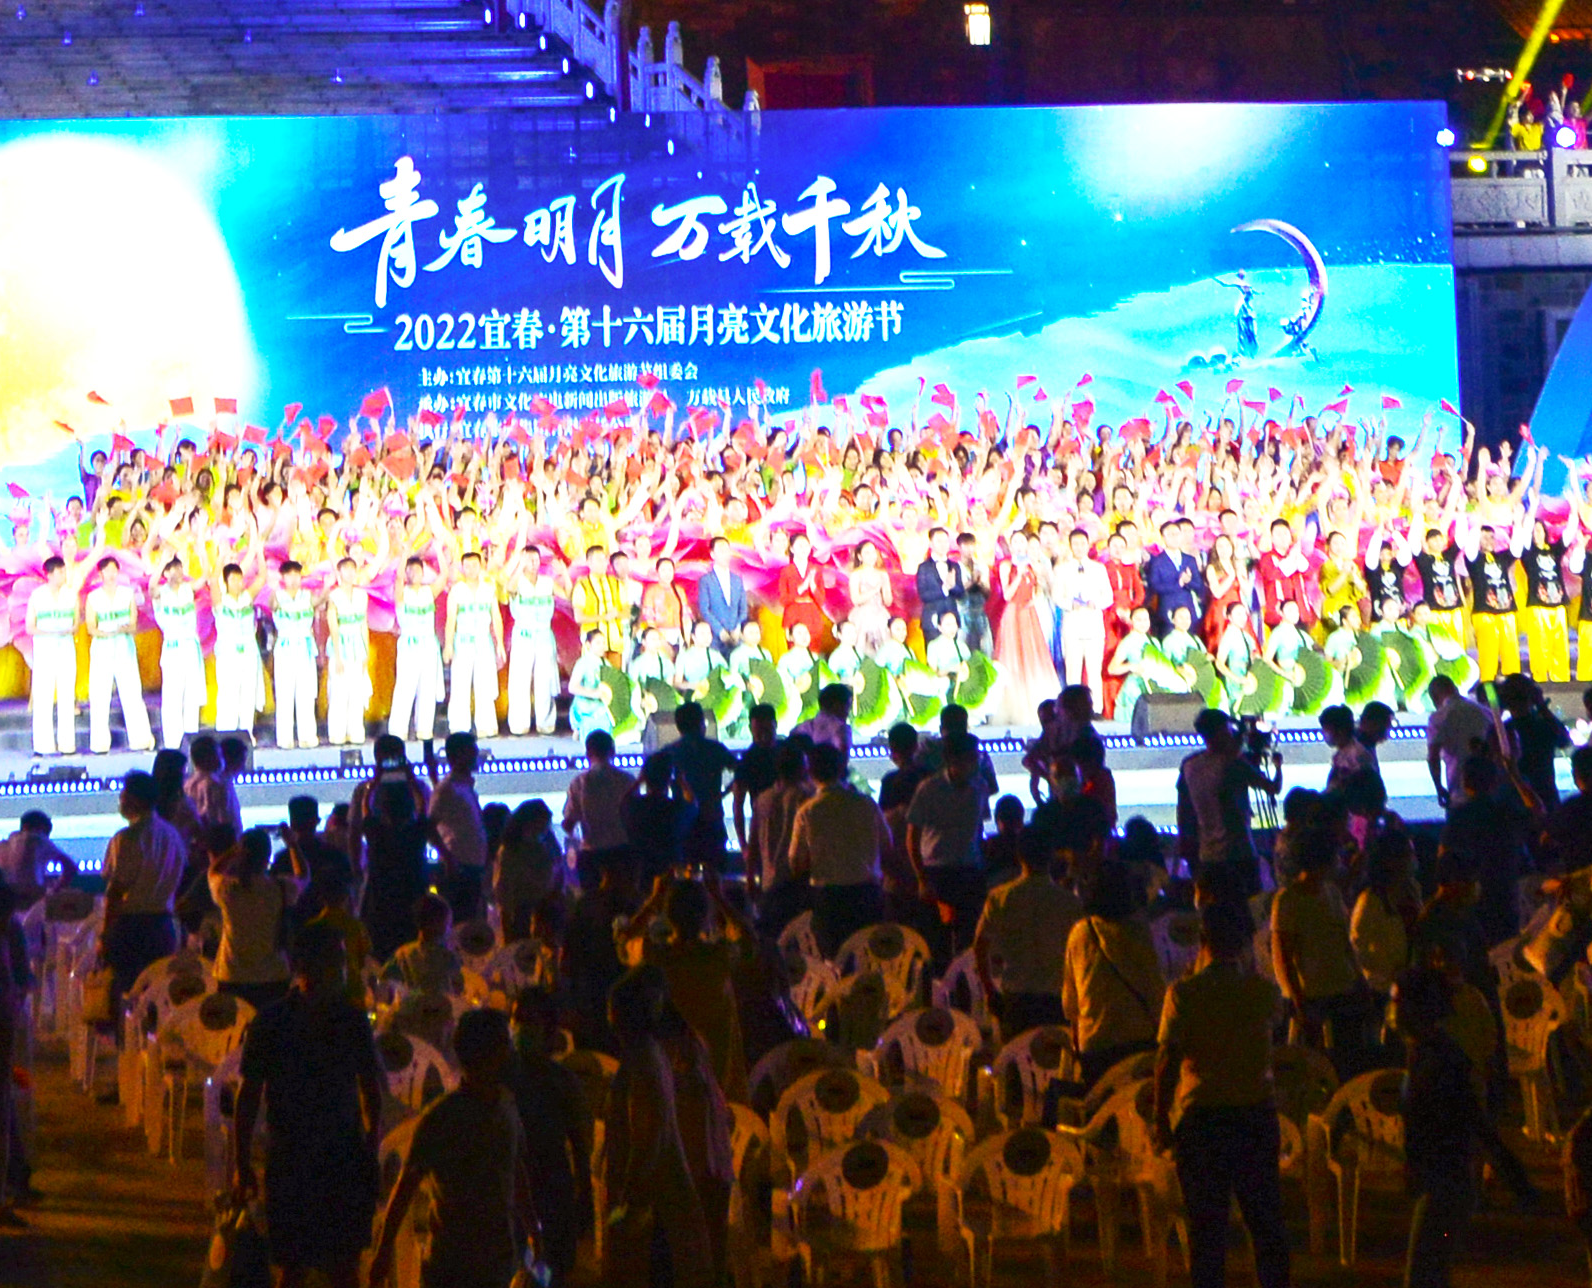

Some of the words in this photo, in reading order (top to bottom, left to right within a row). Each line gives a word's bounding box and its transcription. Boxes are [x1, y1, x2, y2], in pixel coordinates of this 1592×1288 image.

[329, 155, 626, 309] 青春明月
[651, 175, 948, 285] 万载千秋
[393, 299, 905, 352] 2022宜春·第十六届月亮文化旅游节
